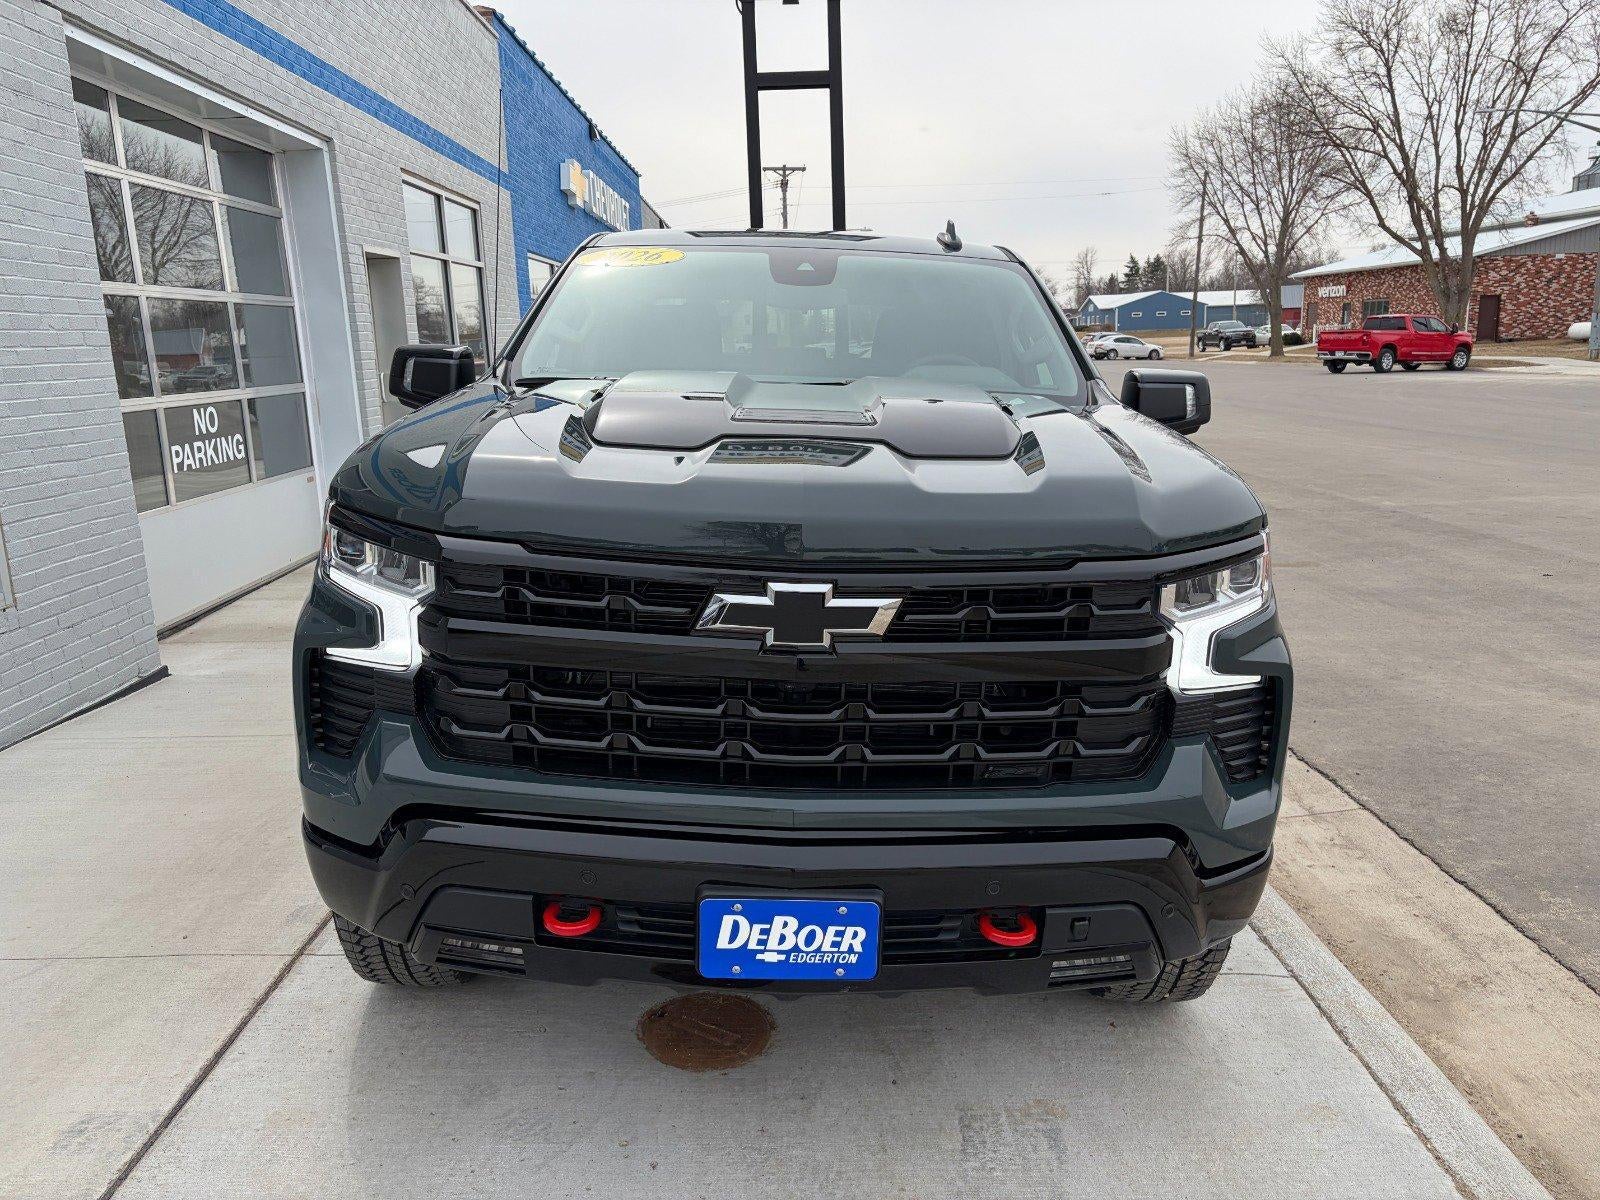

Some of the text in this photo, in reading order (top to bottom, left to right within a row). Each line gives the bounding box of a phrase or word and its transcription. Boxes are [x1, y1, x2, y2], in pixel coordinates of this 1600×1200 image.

[1318, 283, 1346, 298] verizon
[193, 406, 218, 435] NO
[171, 433, 245, 473] PARKING
[789, 952, 858, 964] EDGERTON
